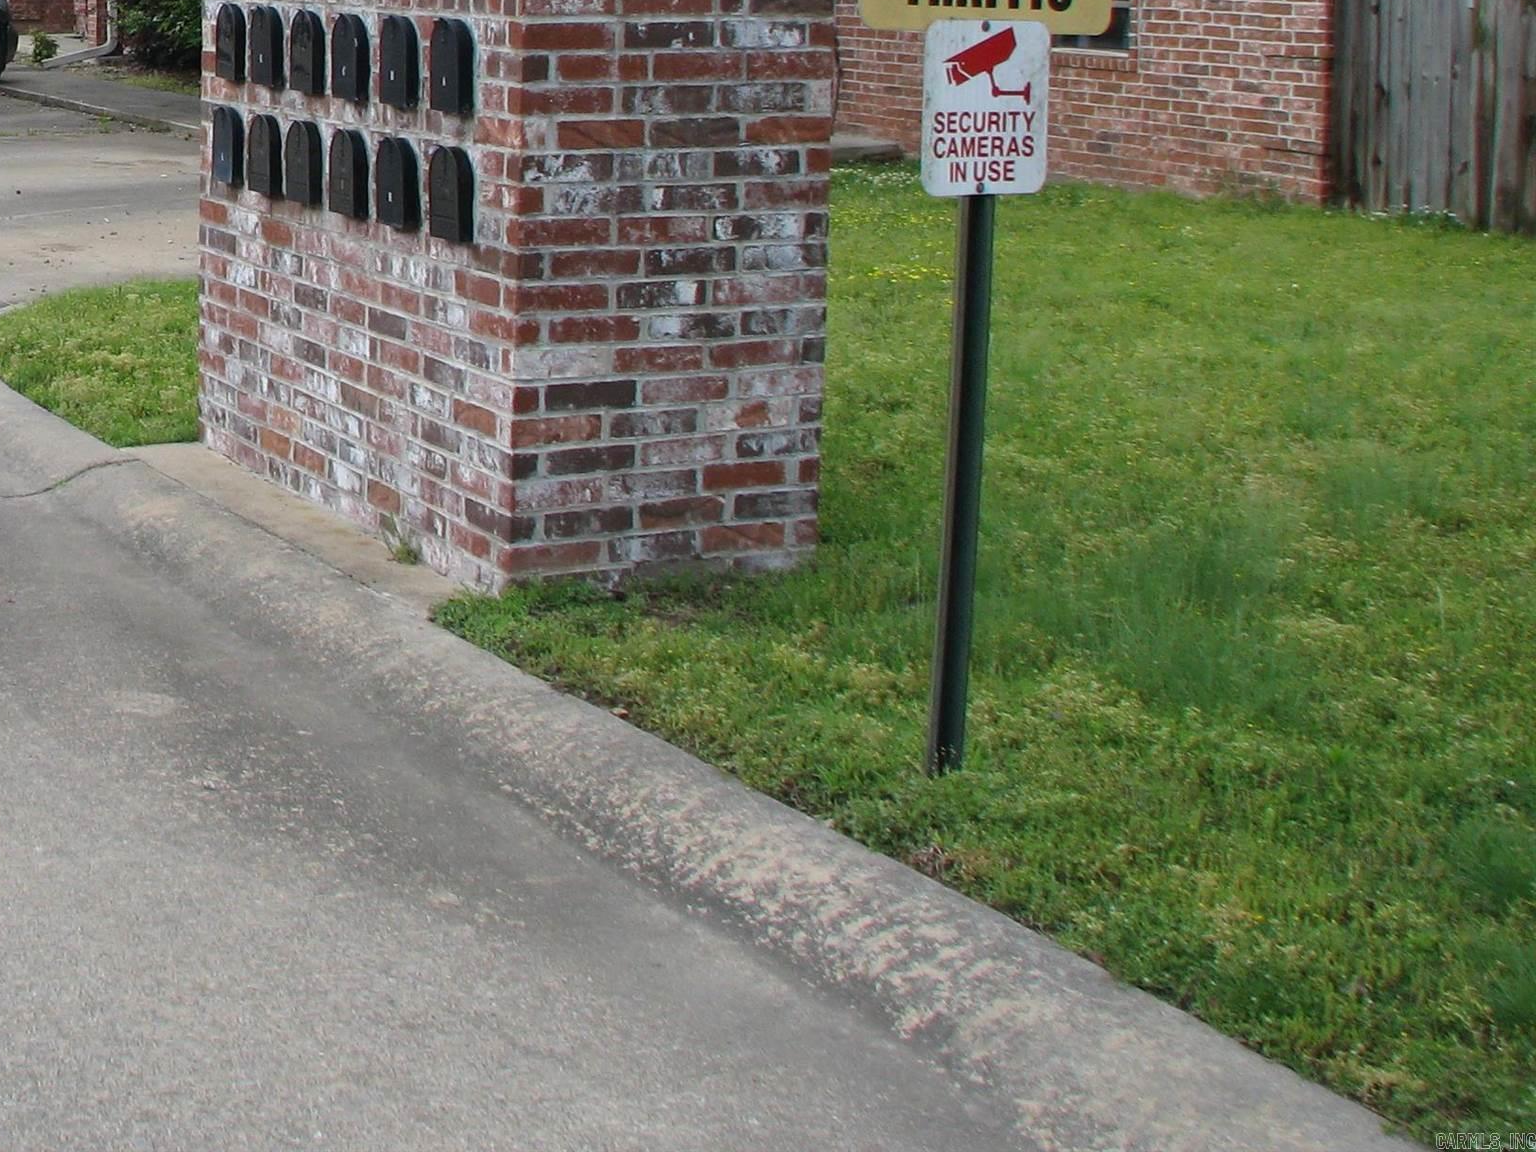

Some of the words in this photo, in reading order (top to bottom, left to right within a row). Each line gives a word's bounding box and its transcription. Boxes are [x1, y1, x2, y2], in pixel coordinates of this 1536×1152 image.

[933, 111, 1035, 134] SECURITY
[933, 135, 1034, 159] CAMERAS
[950, 161, 966, 183] IN
[973, 160, 1015, 182] USE
